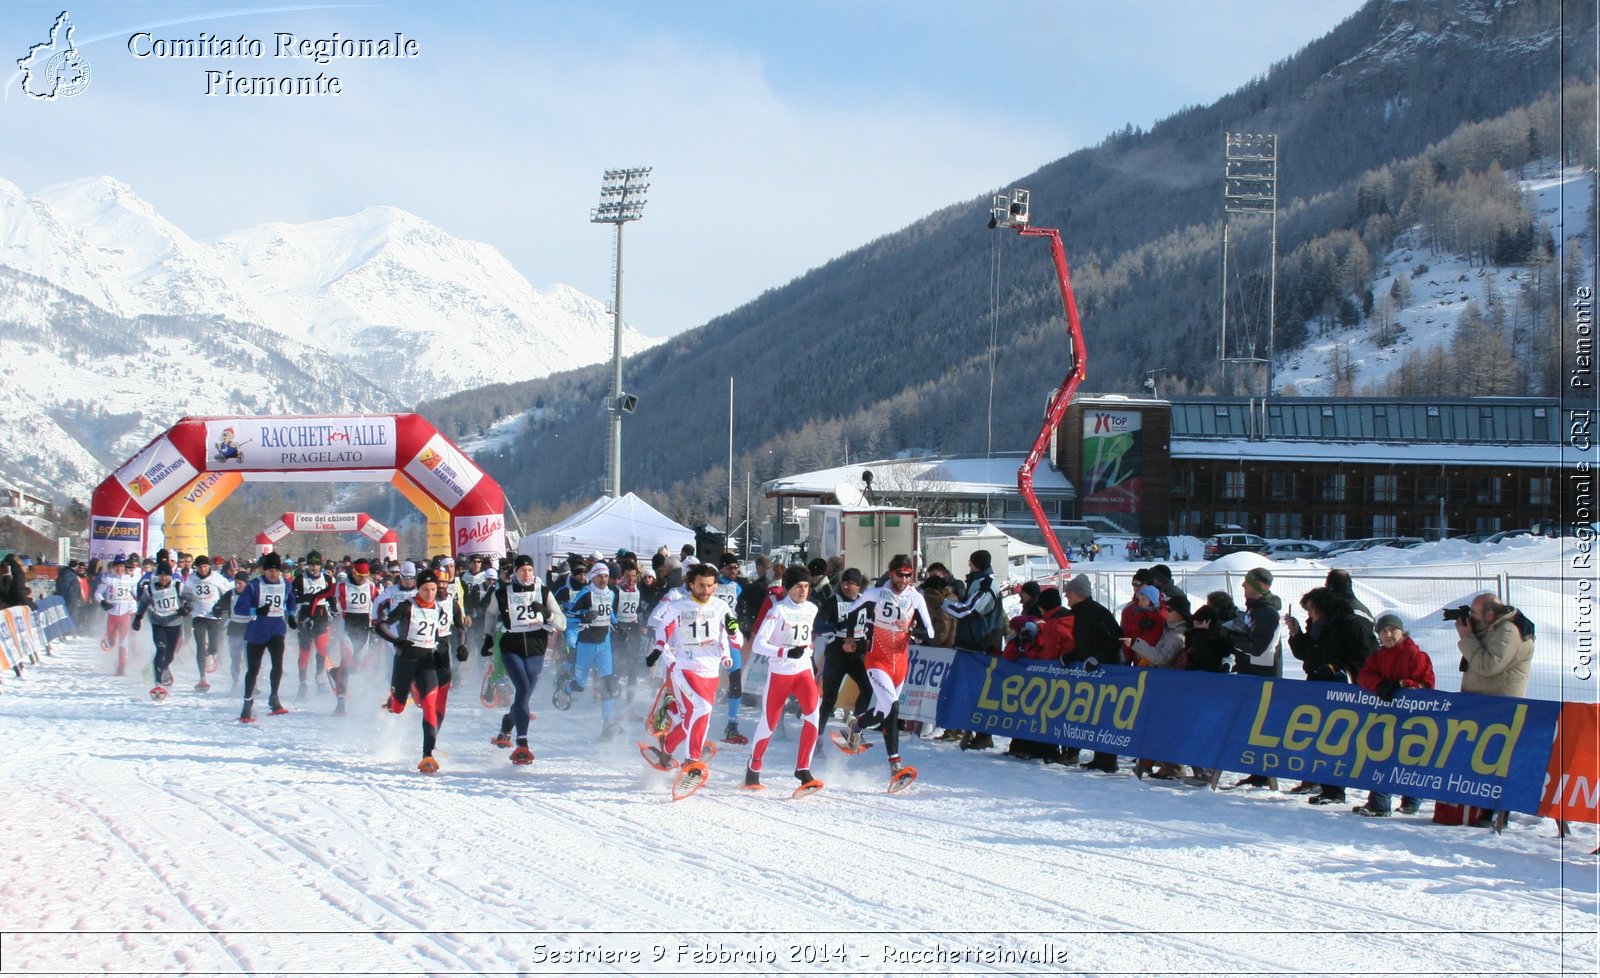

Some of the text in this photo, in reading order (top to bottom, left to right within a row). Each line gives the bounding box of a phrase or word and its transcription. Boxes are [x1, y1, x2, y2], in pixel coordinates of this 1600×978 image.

[1111, 416, 1128, 425] TOP
[281, 451, 363, 464] PRAGELATO
[145, 462, 166, 480] TURIN
[151, 457, 186, 487] MARATHON
[440, 461, 459, 480] TURIN
[433, 467, 465, 497] MARATHON
[315, 514, 326, 522] del
[328, 514, 355, 522] chisone
[94, 523, 140, 537] Leopard
[457, 518, 502, 548] Baldas
[117, 588, 129, 597] 31
[196, 585, 210, 595] 33
[351, 592, 367, 605] 20
[157, 597, 176, 609] 107
[265, 595, 281, 608] 59
[623, 601, 637, 613] 26
[516, 605, 537, 620] 25
[882, 602, 901, 619] 51
[417, 621, 435, 636] 21
[689, 621, 709, 638] 11
[791, 624, 809, 641] 13
[977, 657, 1148, 734] Leopard
[1326, 690, 1453, 713] www.leopardsport.it
[971, 711, 1038, 733] sport
[1248, 681, 1528, 779] Leopard
[1054, 723, 1131, 747] by Natura House
[1240, 750, 1347, 778] sport
[1372, 766, 1503, 800] by Natura House
